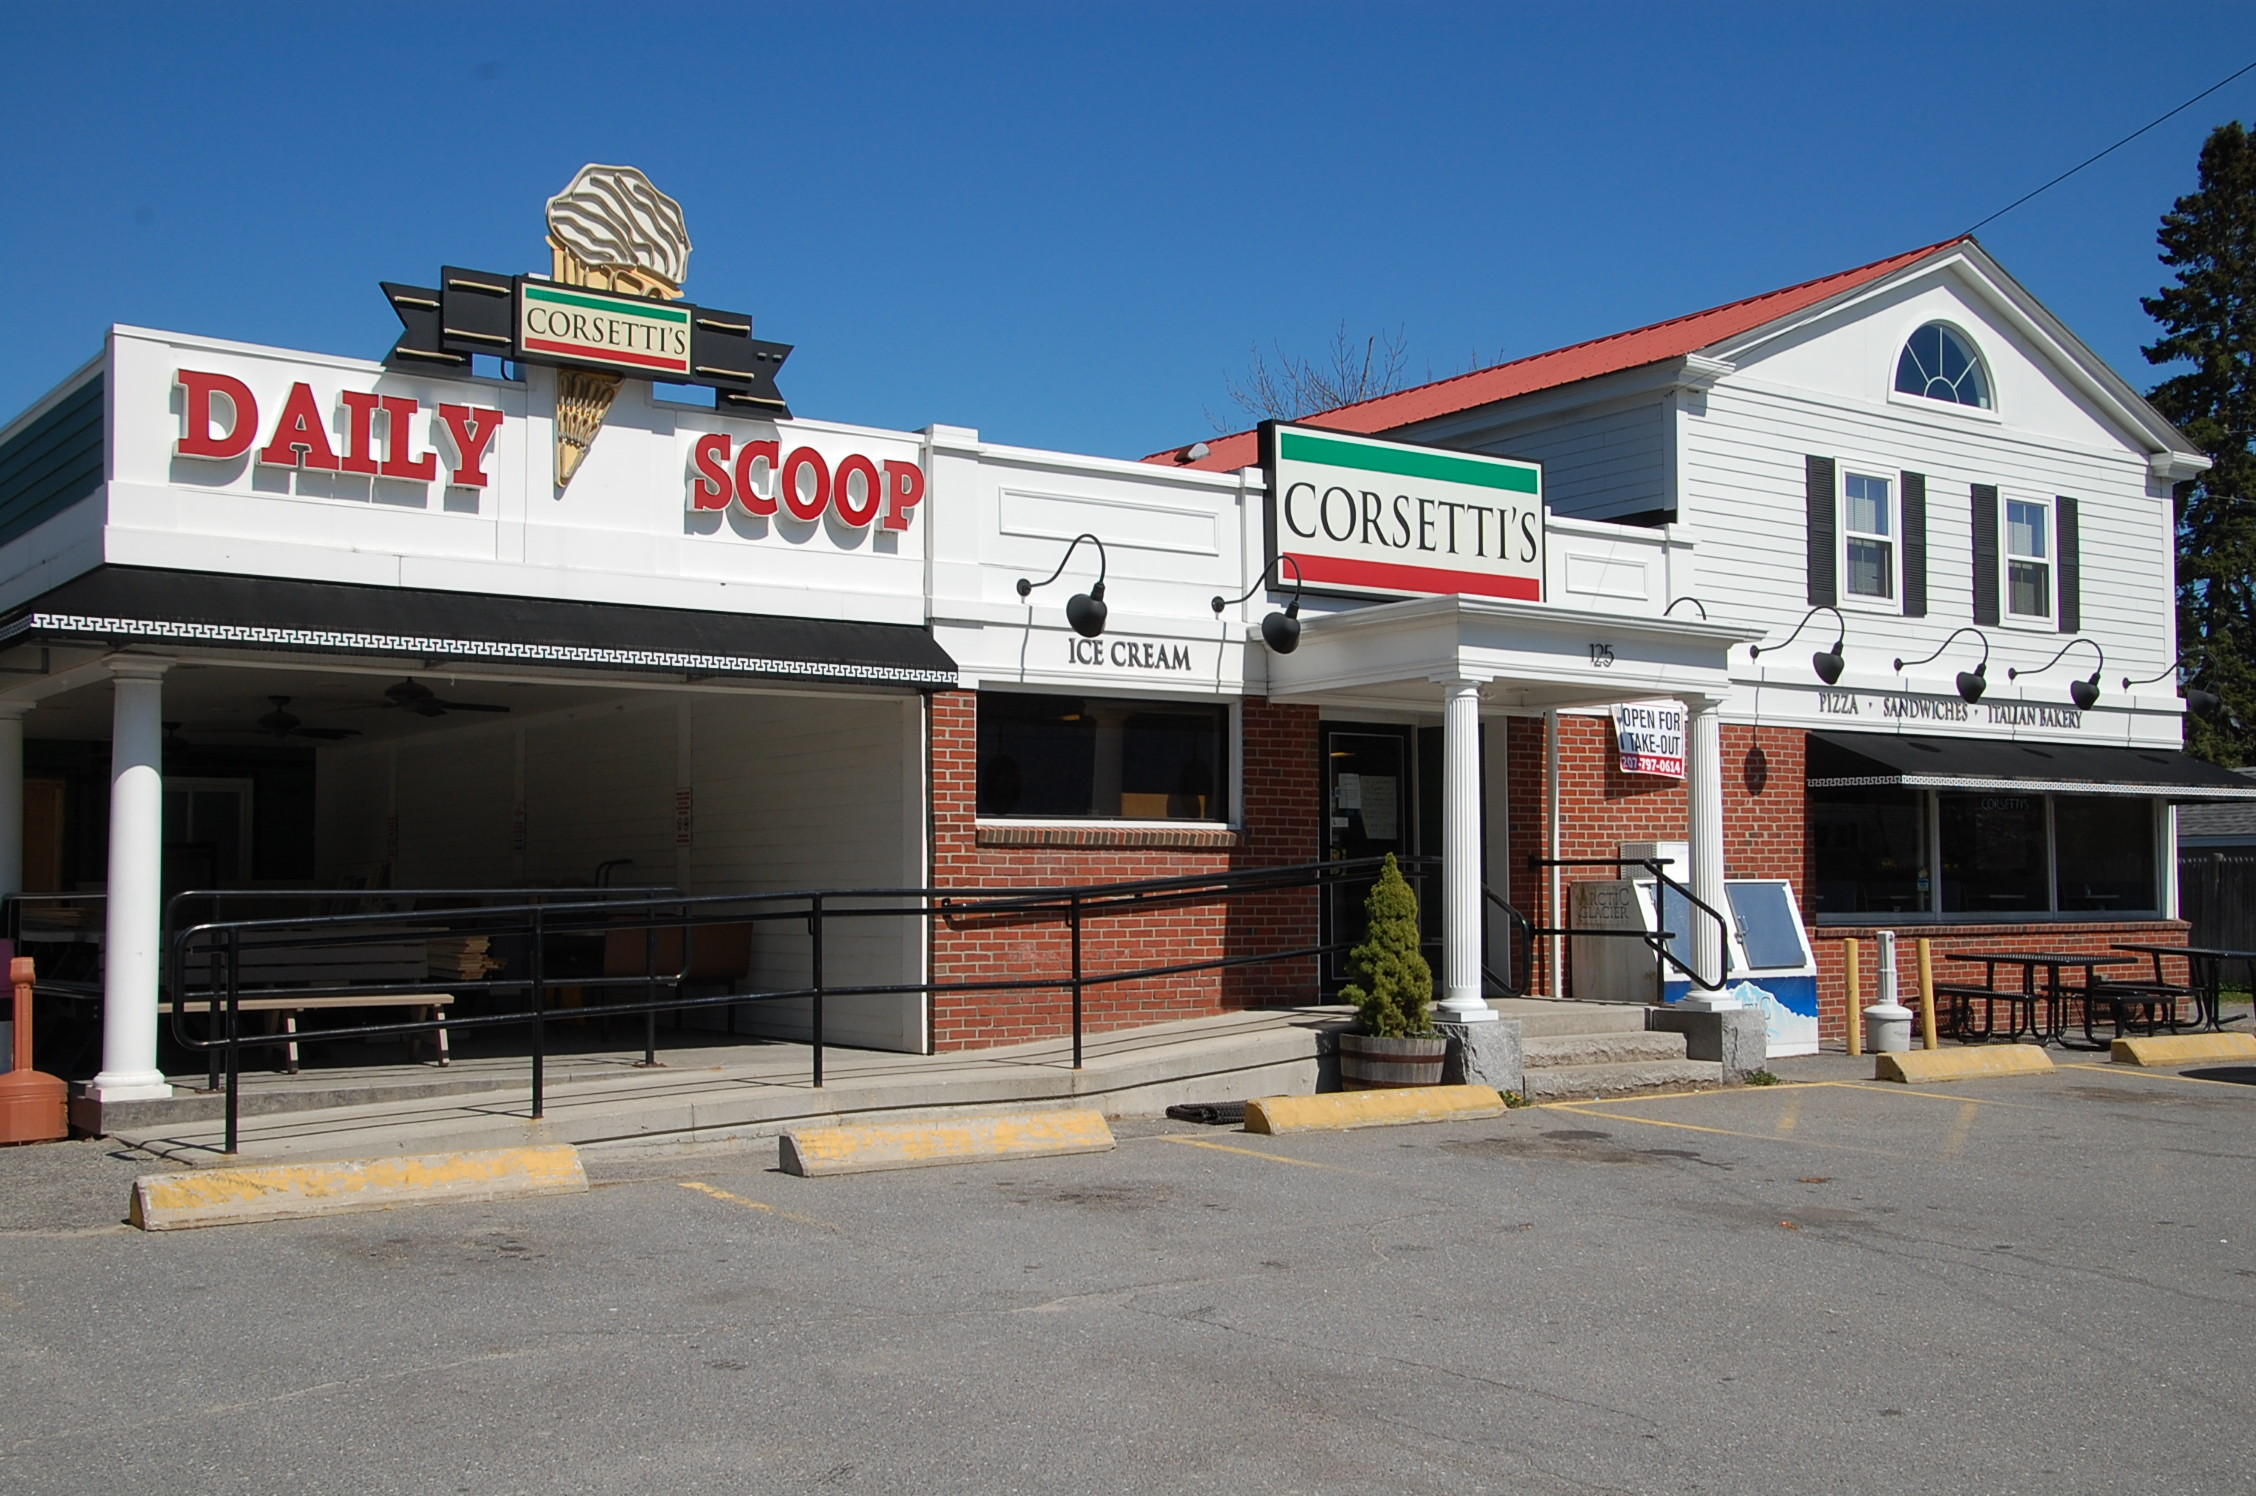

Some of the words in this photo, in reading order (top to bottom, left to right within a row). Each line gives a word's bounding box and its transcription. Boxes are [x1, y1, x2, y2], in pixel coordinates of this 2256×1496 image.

[527, 307, 686, 355] CORSETTI'S
[175, 368, 504, 487] DAILY
[688, 433, 925, 531] SCOOP
[1284, 482, 1537, 563] CORSETTI'S
[1068, 637, 1104, 666] ICE
[1110, 641, 1192, 671] CREAM
[1588, 643, 1615, 668] 125
[1622, 707, 1655, 729] OPEN
[1658, 711, 1681, 731] FOR
[1818, 692, 1859, 715] PIZZA
[1883, 697, 1968, 721] SANDWICHES
[1987, 704, 2036, 726] ITALIAN
[2039, 707, 2082, 729] BAKERY
[1629, 732, 1681, 755] TAKE-OUT
